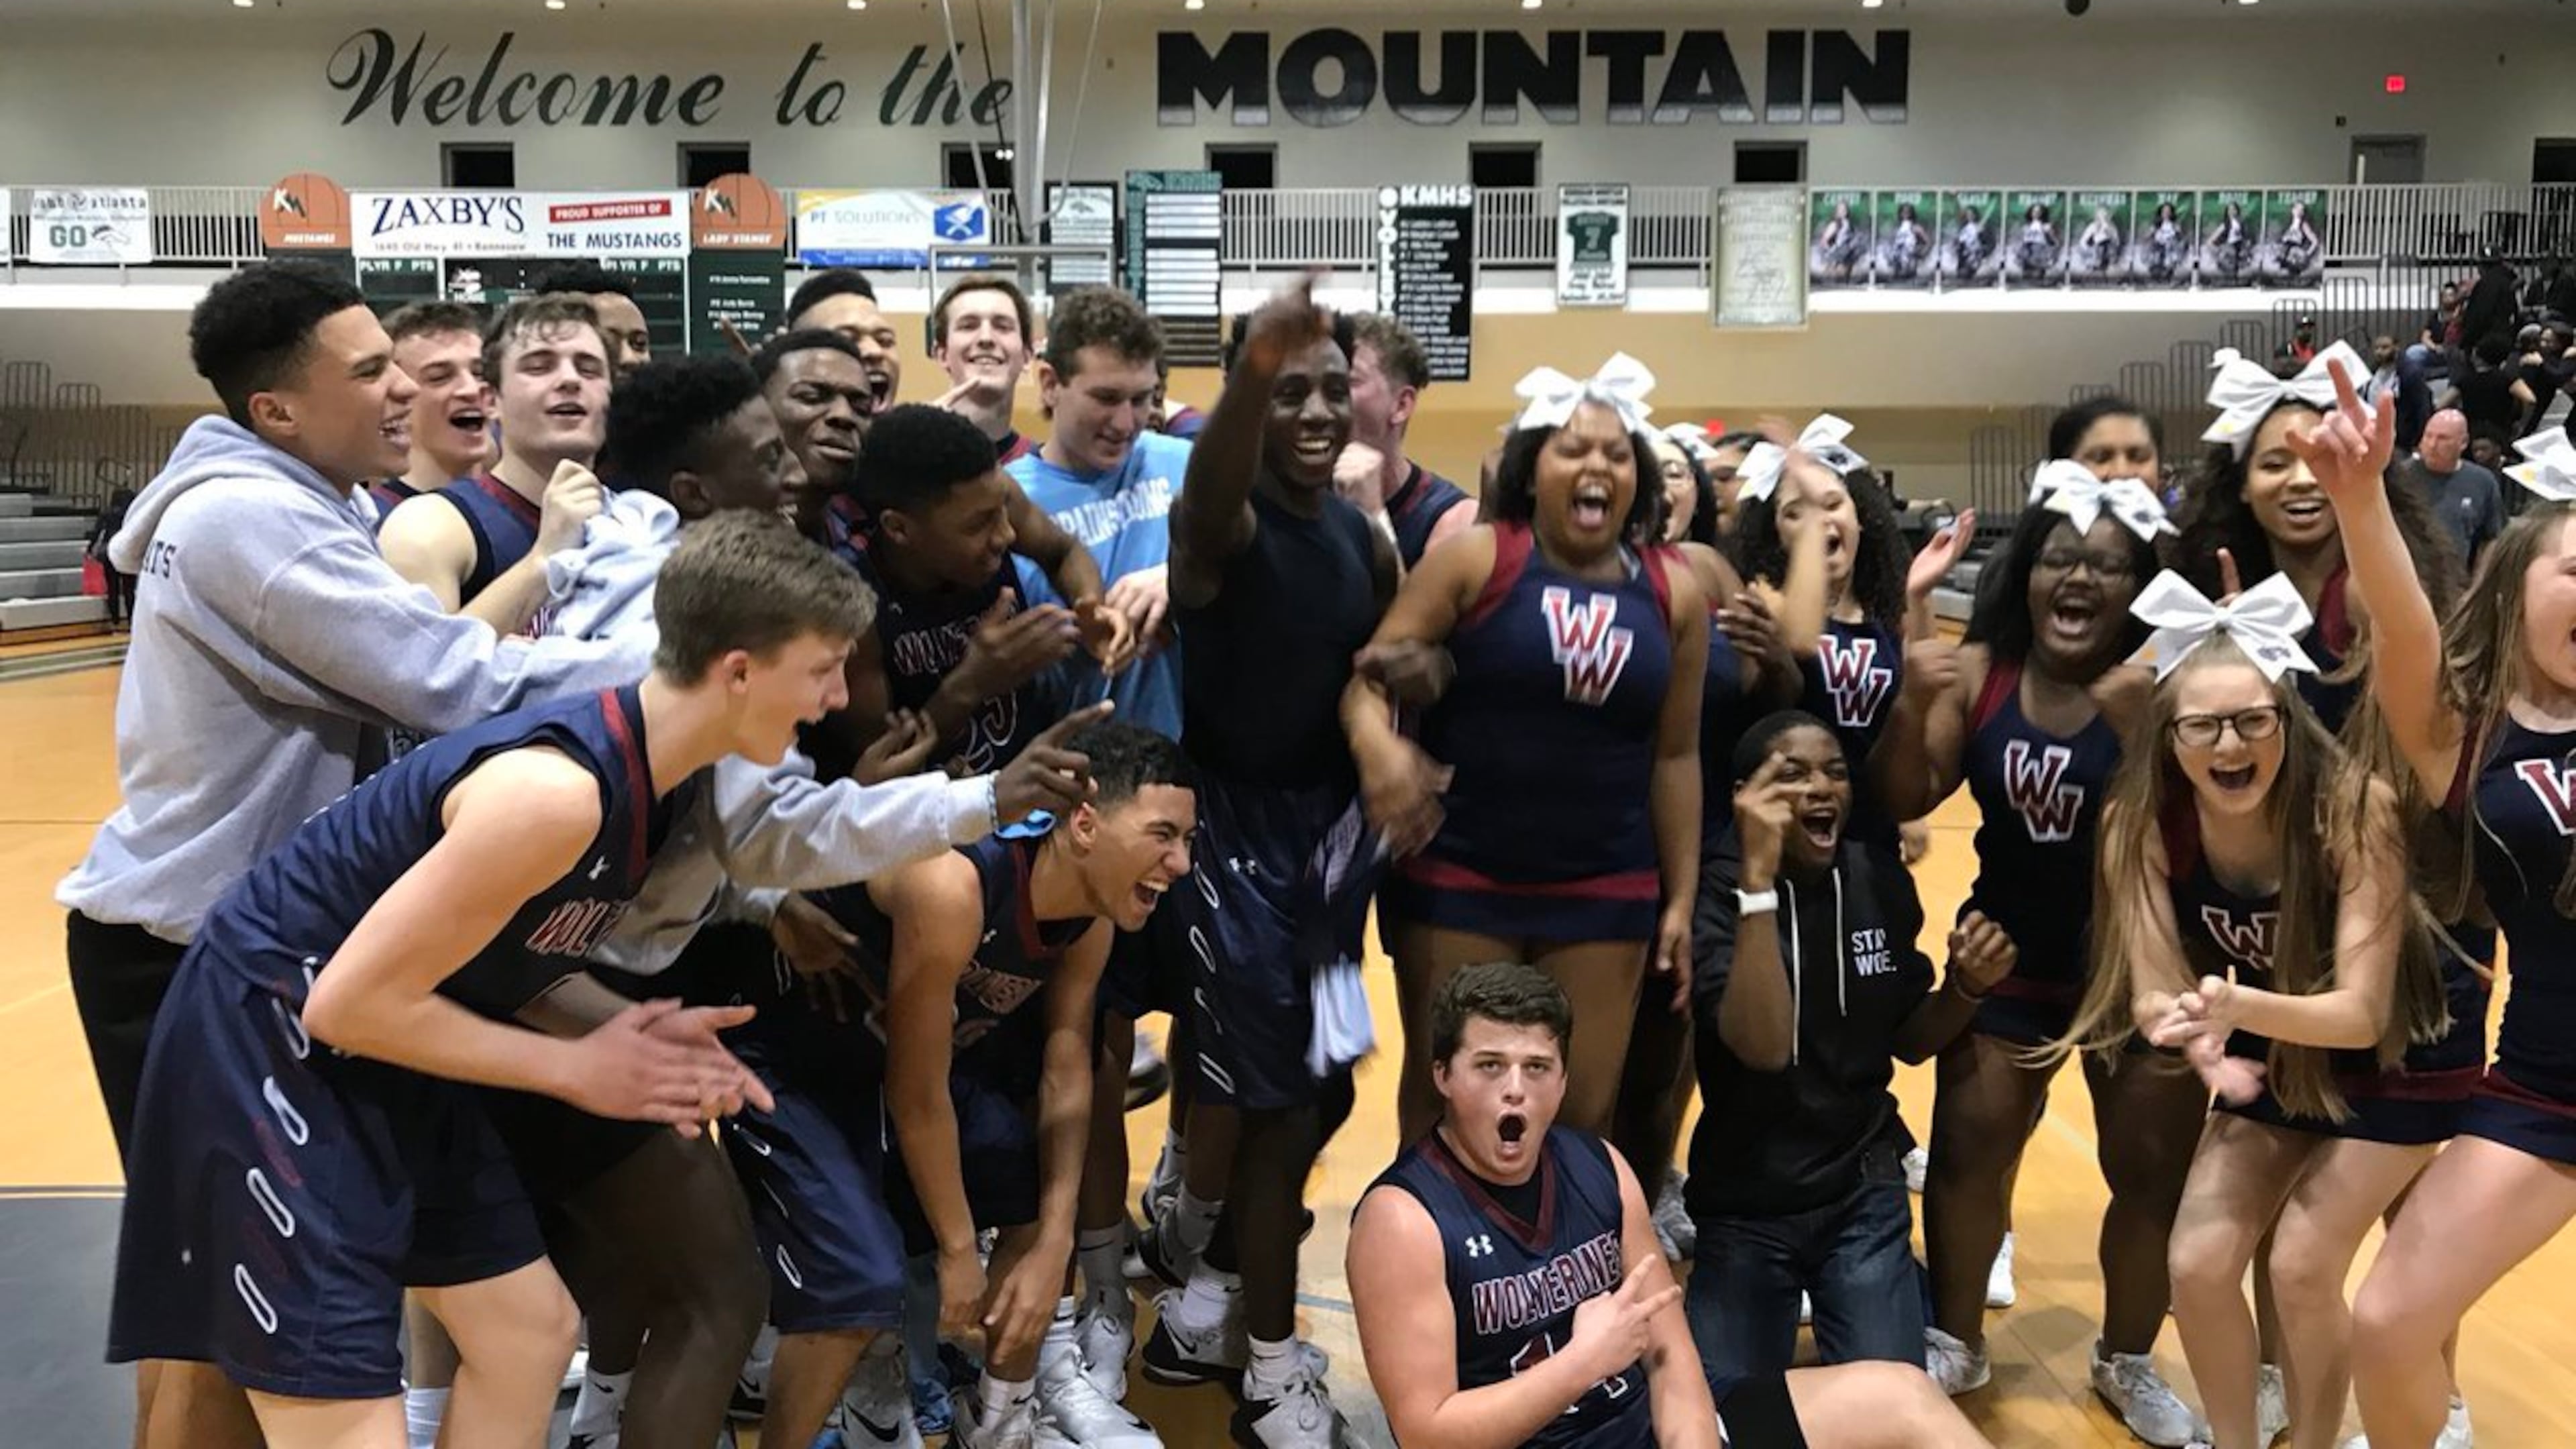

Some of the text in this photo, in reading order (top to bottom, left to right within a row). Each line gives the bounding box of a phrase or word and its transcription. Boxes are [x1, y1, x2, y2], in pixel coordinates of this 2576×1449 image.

[327, 28, 1012, 126] Welcome to the
[1158, 29, 1909, 126] MOUNTAIN
[1400, 184, 1472, 206] KMHS
[371, 196, 525, 236] ZAXBY'S
[592, 203, 646, 218] SUPPORTER
[810, 211, 826, 223] PT
[50, 225, 87, 248] GO
[547, 232, 682, 248] THE MUSTANGS
